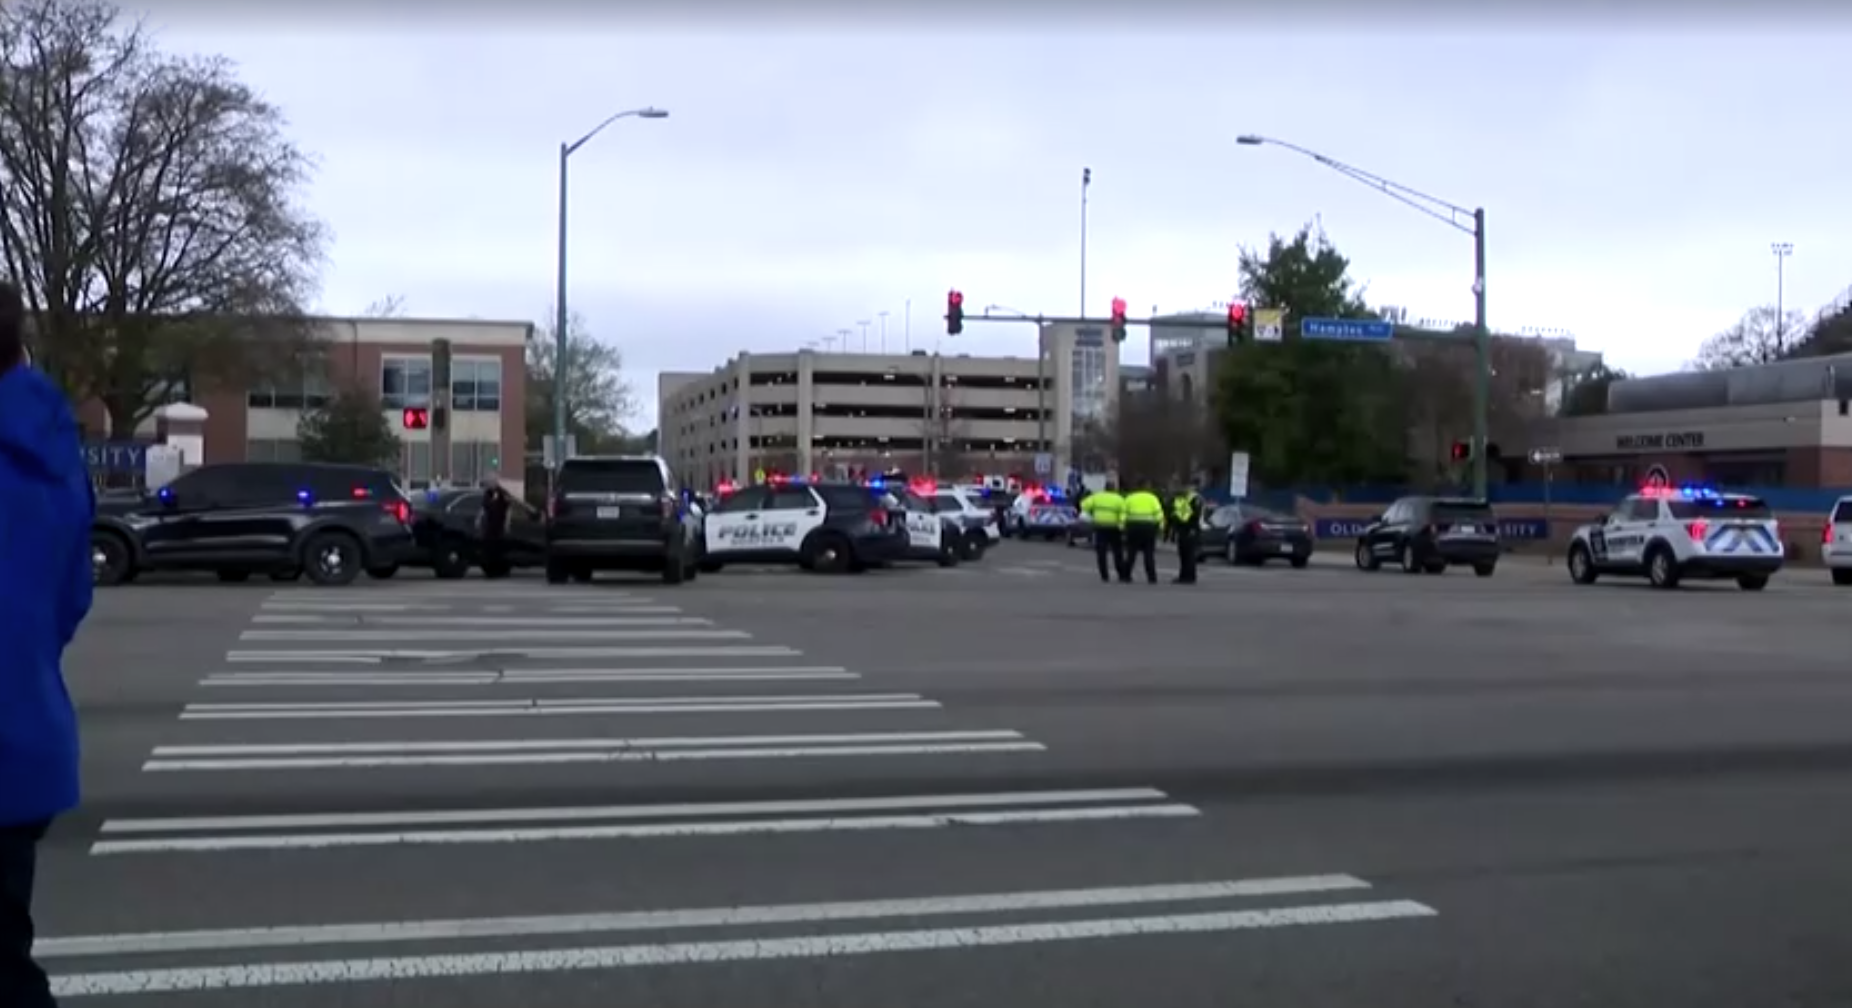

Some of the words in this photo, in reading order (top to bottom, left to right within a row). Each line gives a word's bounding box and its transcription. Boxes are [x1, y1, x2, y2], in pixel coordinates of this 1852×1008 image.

[1616, 434, 1664, 449] WELCOME
[1665, 431, 1704, 447] CENTER
[718, 522, 798, 539] POLICE
